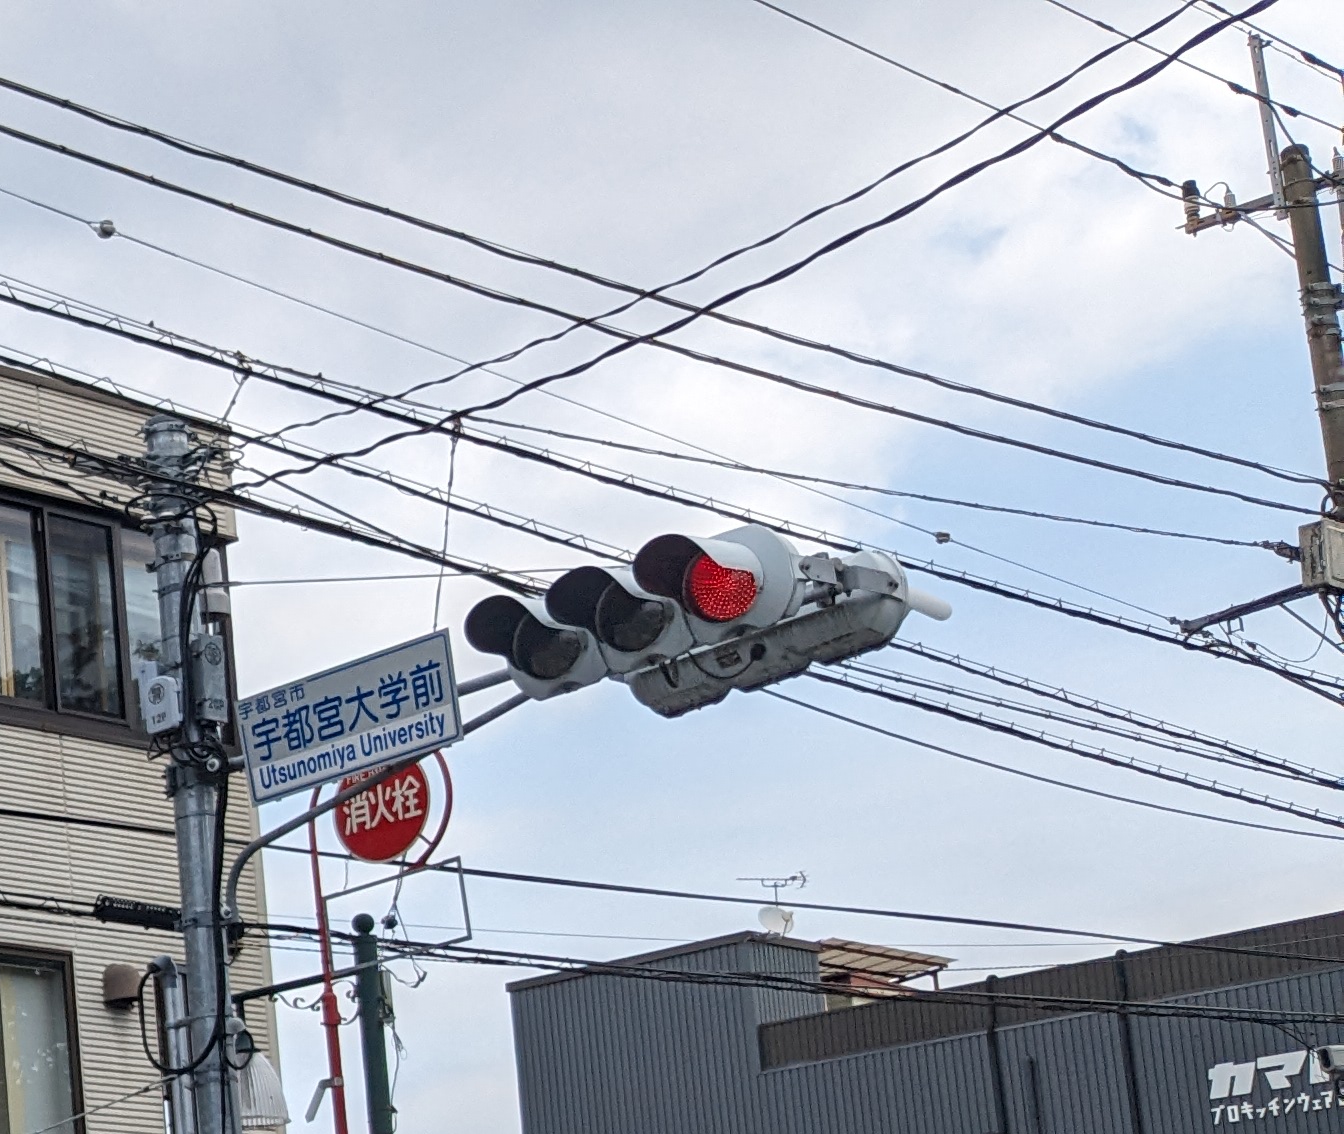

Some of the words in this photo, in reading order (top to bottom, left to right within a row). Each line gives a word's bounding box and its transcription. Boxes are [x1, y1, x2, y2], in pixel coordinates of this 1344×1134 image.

[238, 683, 306, 721] 宇都宮市
[251, 659, 445, 762] 宇都宮大学前
[259, 743, 357, 789] Utsunomiya
[359, 712, 446, 757] University
[342, 774, 423, 836] 消火栓
